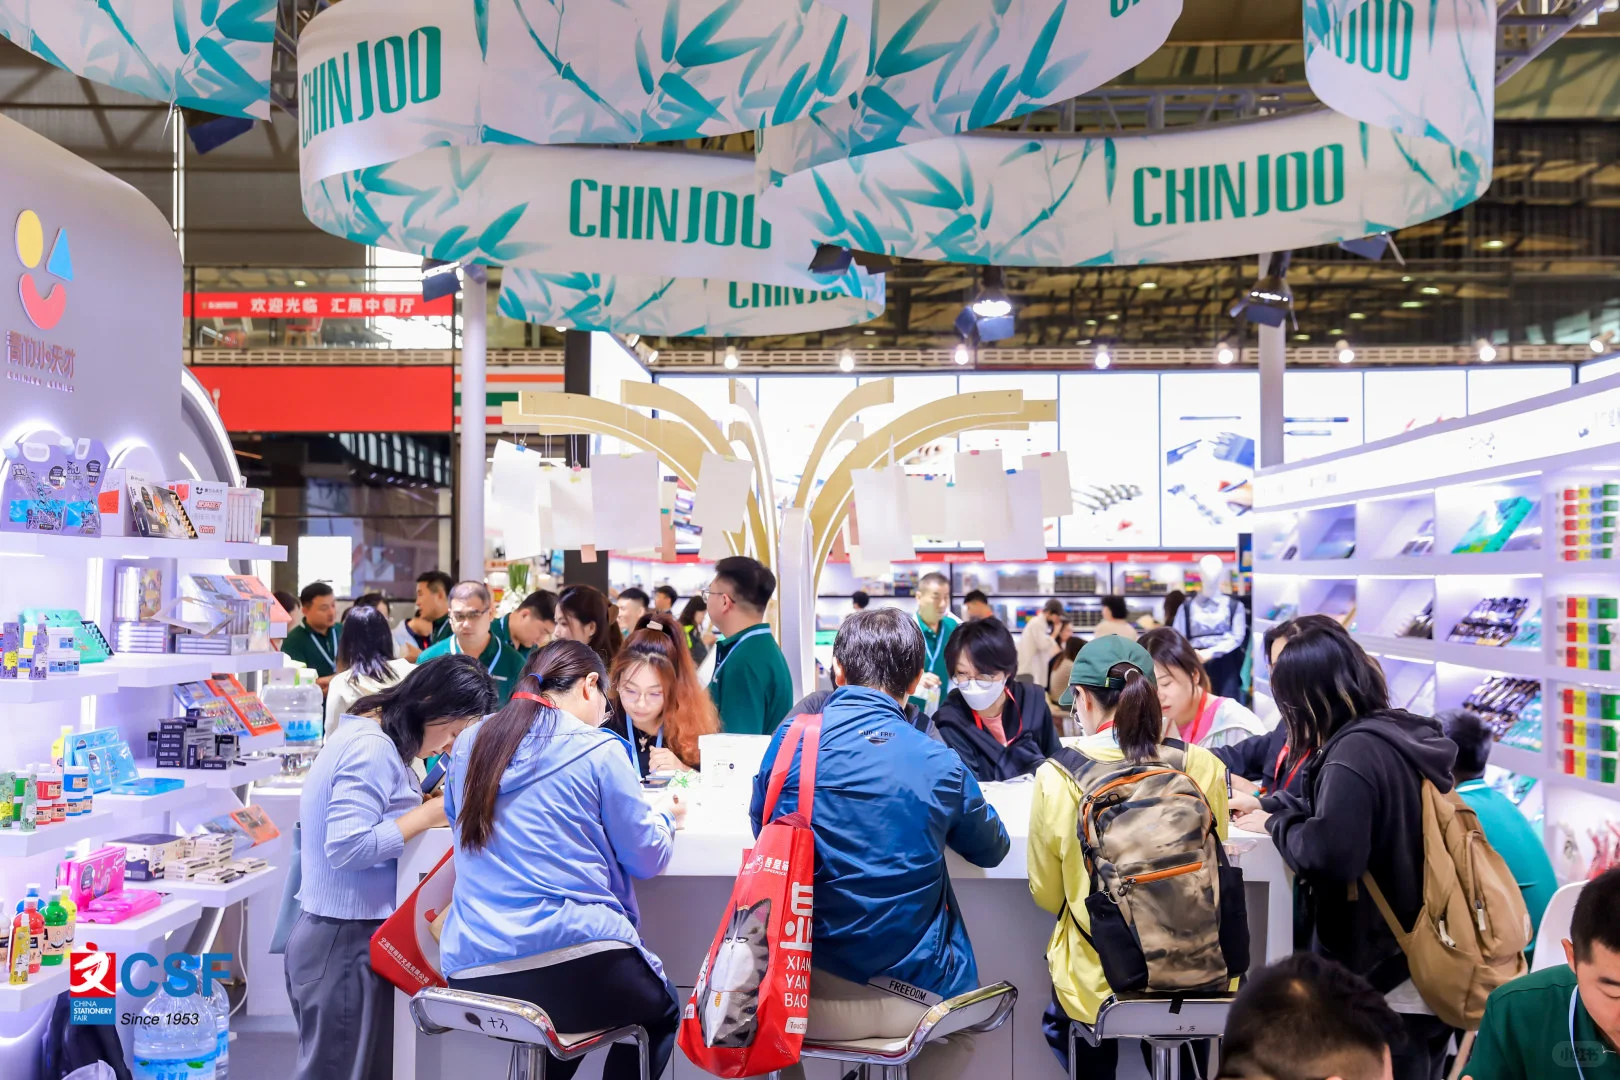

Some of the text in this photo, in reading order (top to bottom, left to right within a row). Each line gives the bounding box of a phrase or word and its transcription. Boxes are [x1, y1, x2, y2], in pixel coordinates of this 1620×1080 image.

[300, 26, 442, 150] CHINJOO
[1133, 143, 1345, 228] CHINJOO
[569, 178, 772, 250] CHINJOO
[250, 297, 318, 314] 欢迎光临
[331, 297, 416, 314] 汇展中餐厅
[784, 992, 808, 1009] BAO
[785, 973, 808, 989] YAN
